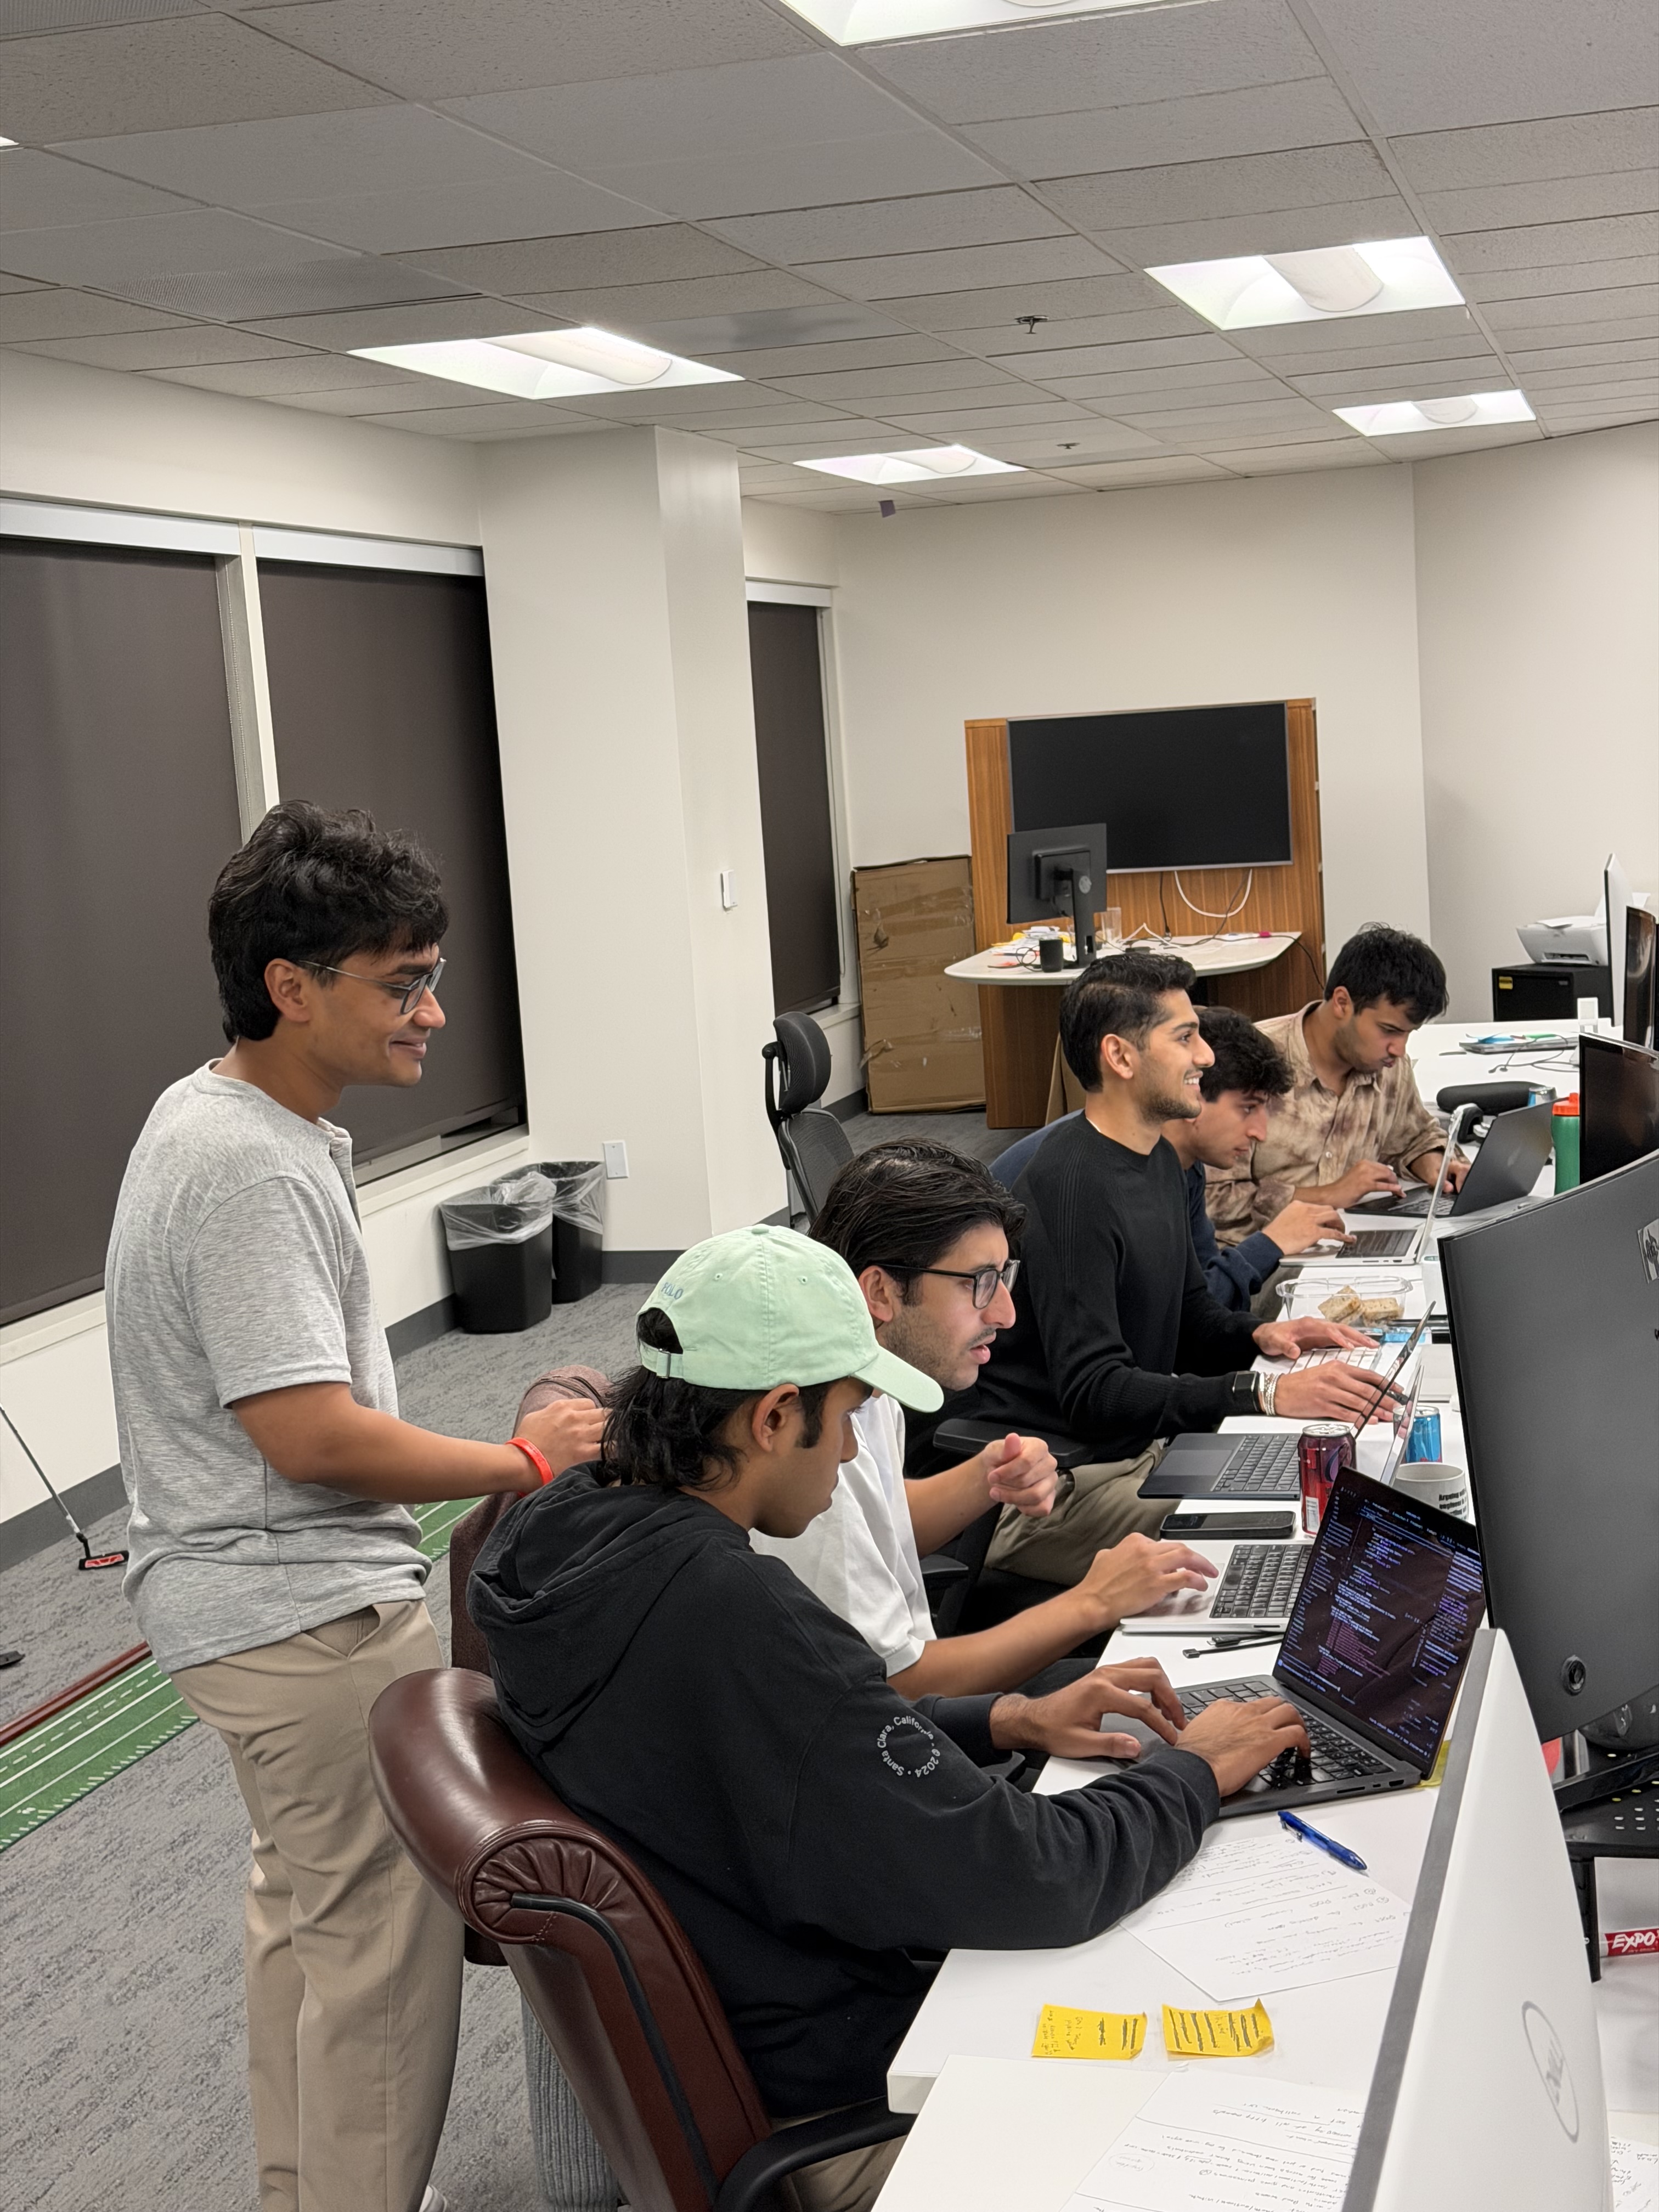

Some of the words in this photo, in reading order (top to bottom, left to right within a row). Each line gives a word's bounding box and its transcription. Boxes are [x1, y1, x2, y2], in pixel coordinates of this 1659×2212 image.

[661, 1282, 684, 1300] POLO
[877, 1725, 894, 1748] Clara,
[893, 1716, 934, 1740] California
[882, 1750, 904, 1776] Santa
[915, 1757, 939, 1778] 2024
[1611, 1931, 1656, 1953] EXPO
